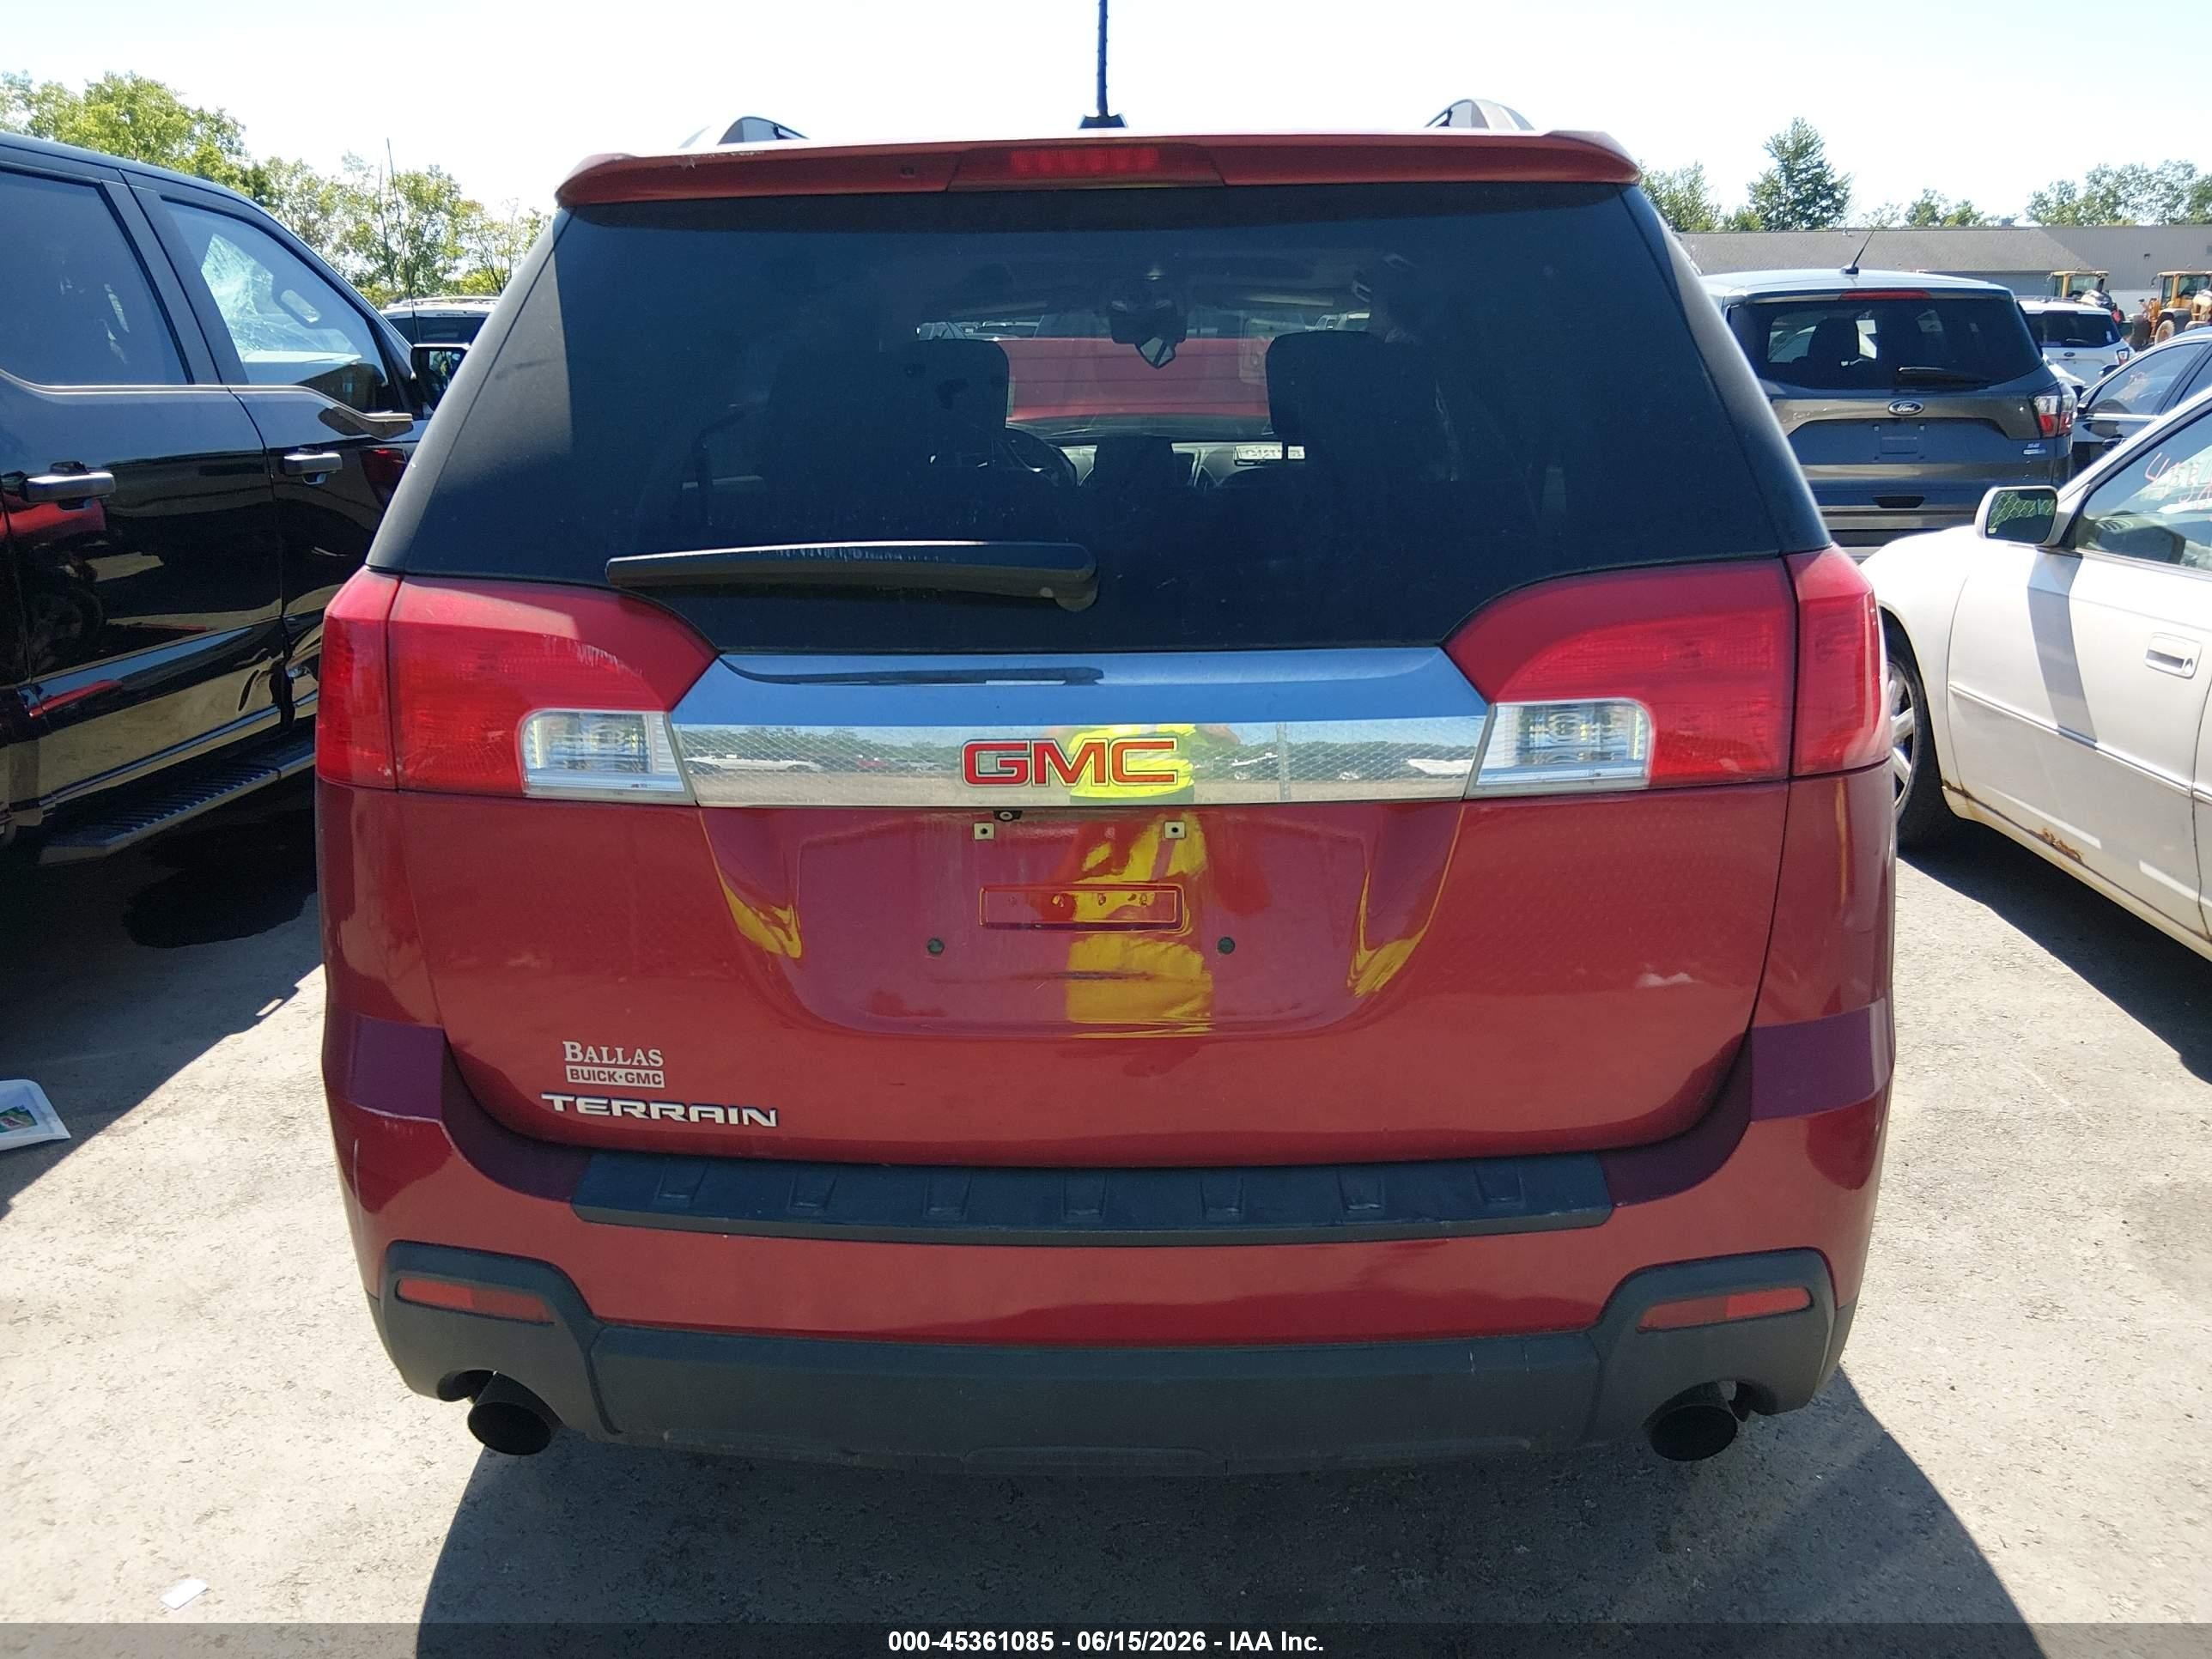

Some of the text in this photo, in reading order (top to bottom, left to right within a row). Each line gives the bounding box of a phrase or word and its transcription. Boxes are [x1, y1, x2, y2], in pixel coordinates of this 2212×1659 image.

[962, 737, 1178, 787] GMC
[562, 1041, 664, 1067] BALLAS
[541, 1093, 777, 1127] TERRAIN
